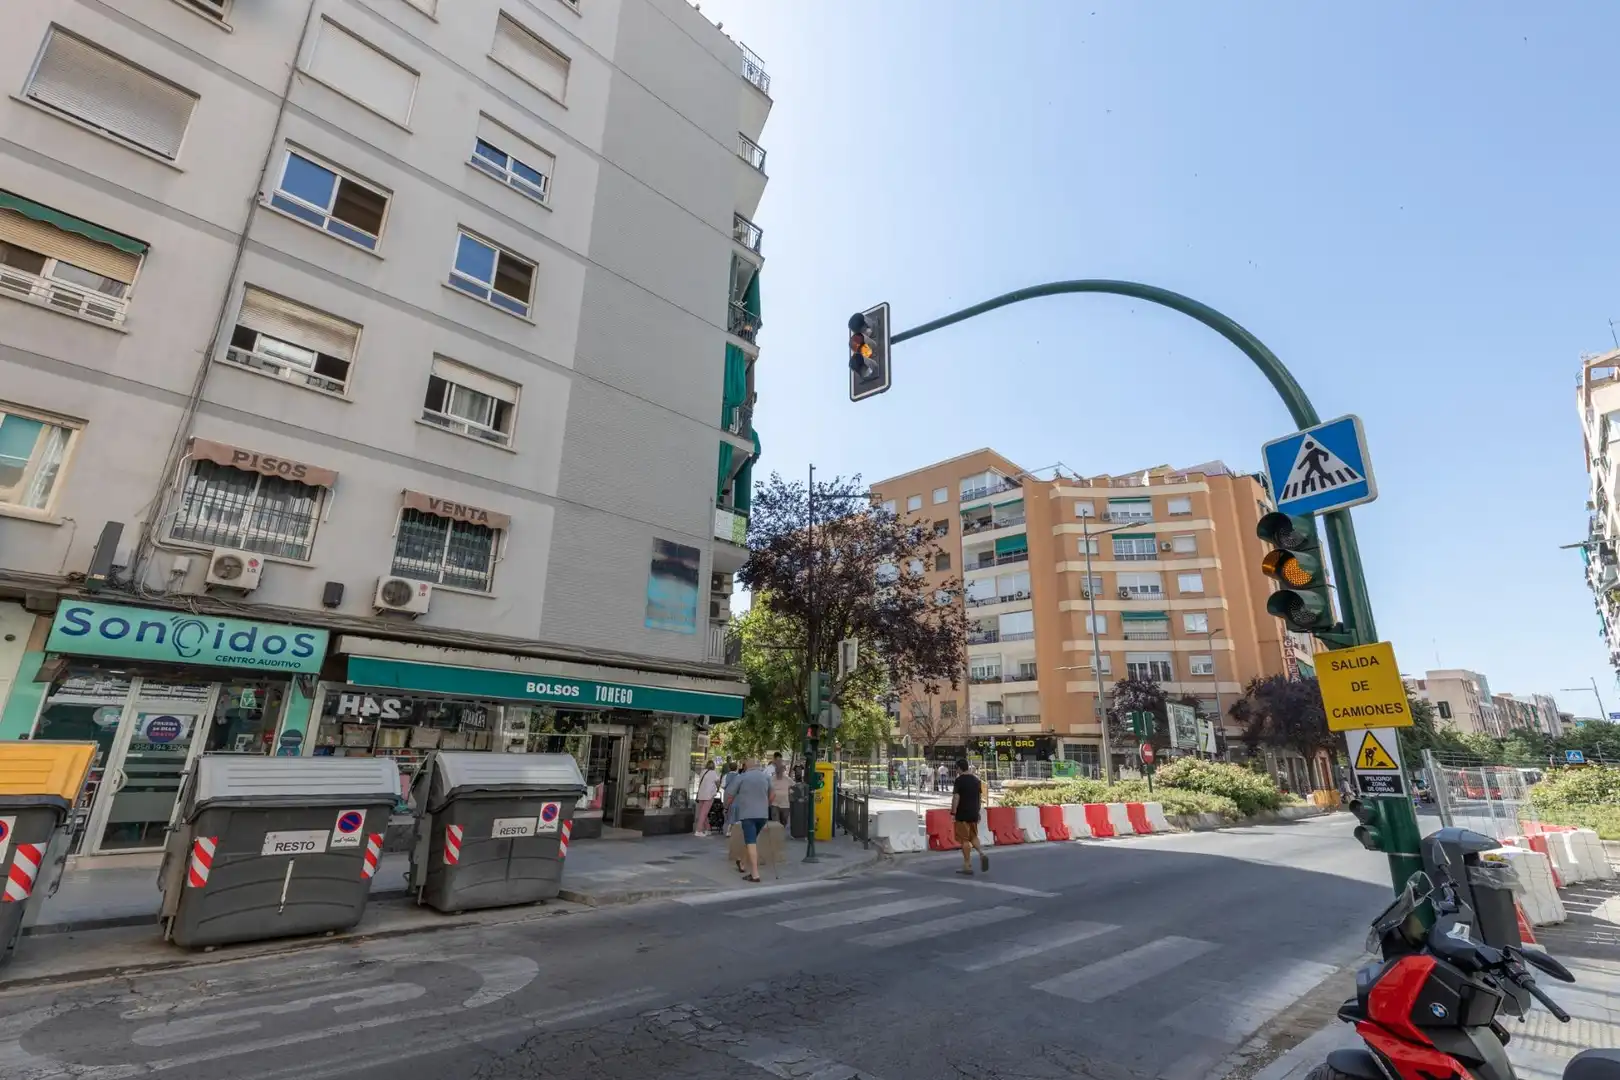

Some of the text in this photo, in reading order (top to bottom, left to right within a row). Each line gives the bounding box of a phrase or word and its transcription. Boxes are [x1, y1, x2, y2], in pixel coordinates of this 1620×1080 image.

[232, 450, 307, 478] PISOS
[428, 497, 489, 522] VENTA
[215, 655, 302, 669] CENTRO AUDITIVO
[1331, 655, 1380, 671] SALIDA
[526, 682, 580, 697] BOLSOS
[1351, 680, 1369, 692] DE
[1332, 702, 1404, 718] CAMIONES
[500, 826, 528, 835] RESTO
[274, 841, 315, 852] RESTO
